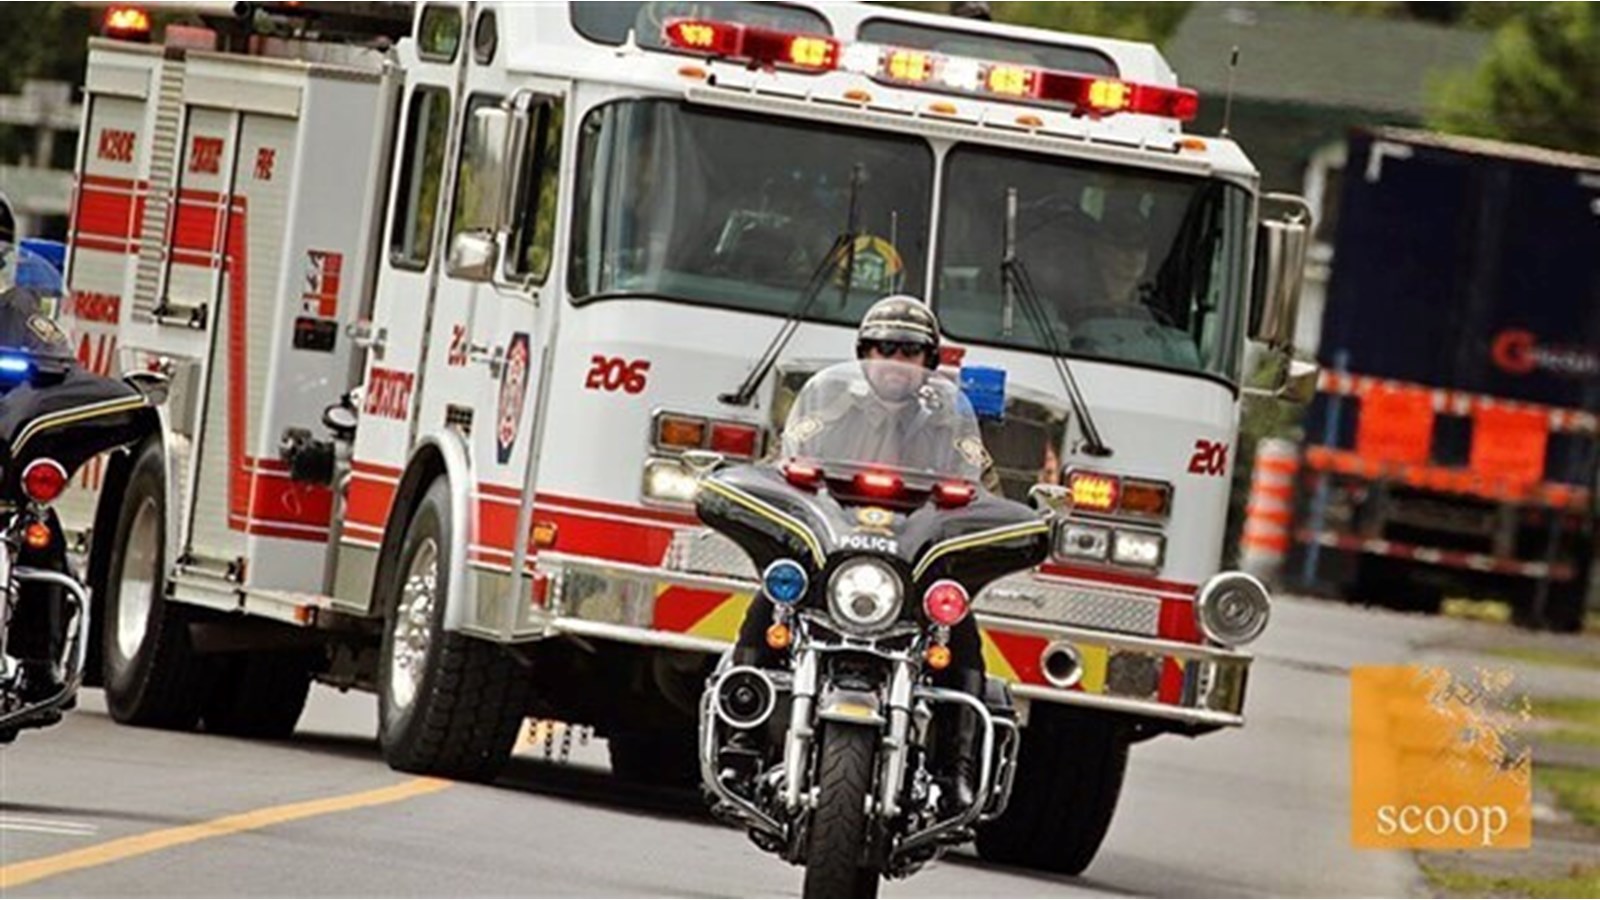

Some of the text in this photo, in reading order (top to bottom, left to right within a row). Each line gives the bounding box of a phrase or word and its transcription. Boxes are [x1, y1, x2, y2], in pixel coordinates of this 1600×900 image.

[584, 354, 652, 396] 206
[1187, 438, 1230, 477] 20
[839, 534, 899, 555] POLICE
